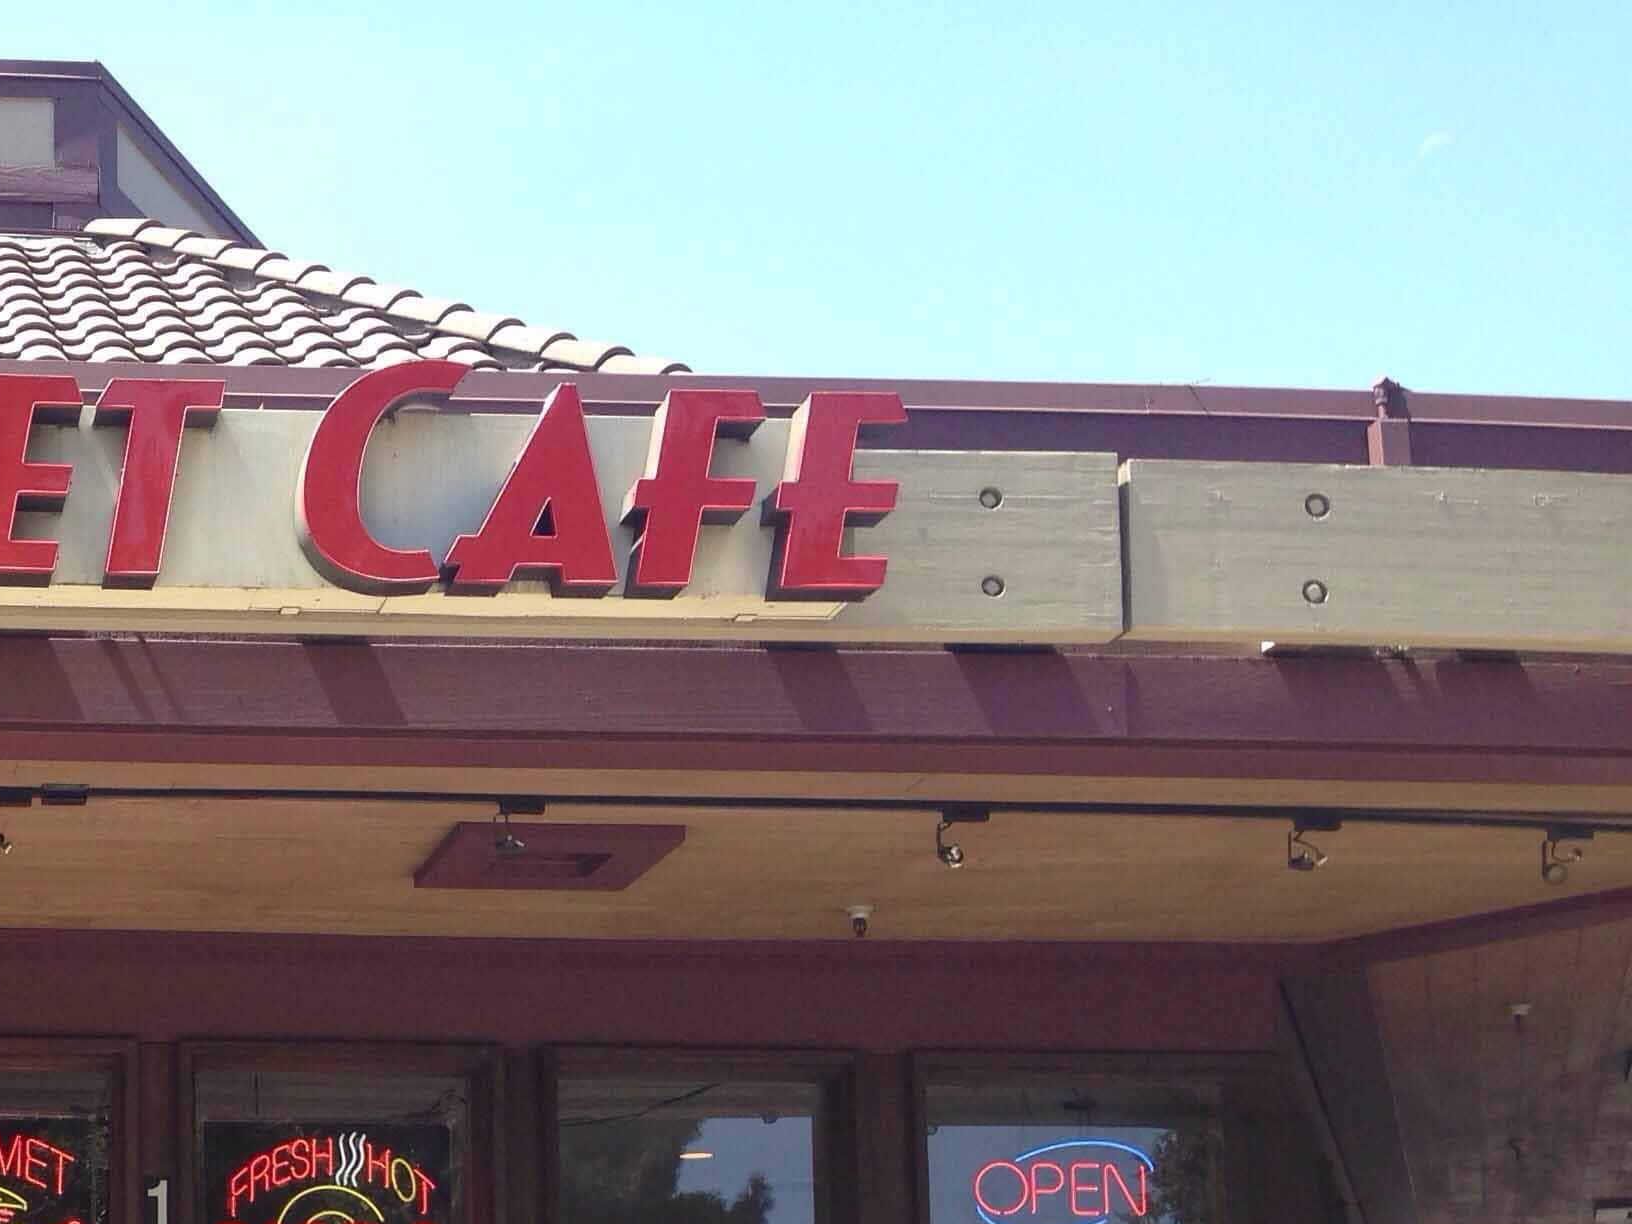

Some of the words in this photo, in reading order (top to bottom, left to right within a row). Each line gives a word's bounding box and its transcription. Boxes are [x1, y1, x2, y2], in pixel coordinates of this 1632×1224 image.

[294, 360, 908, 599] CAFE
[227, 1137, 334, 1217] FRESH
[366, 1143, 437, 1215] HOT
[974, 1161, 1148, 1217] OPEN
